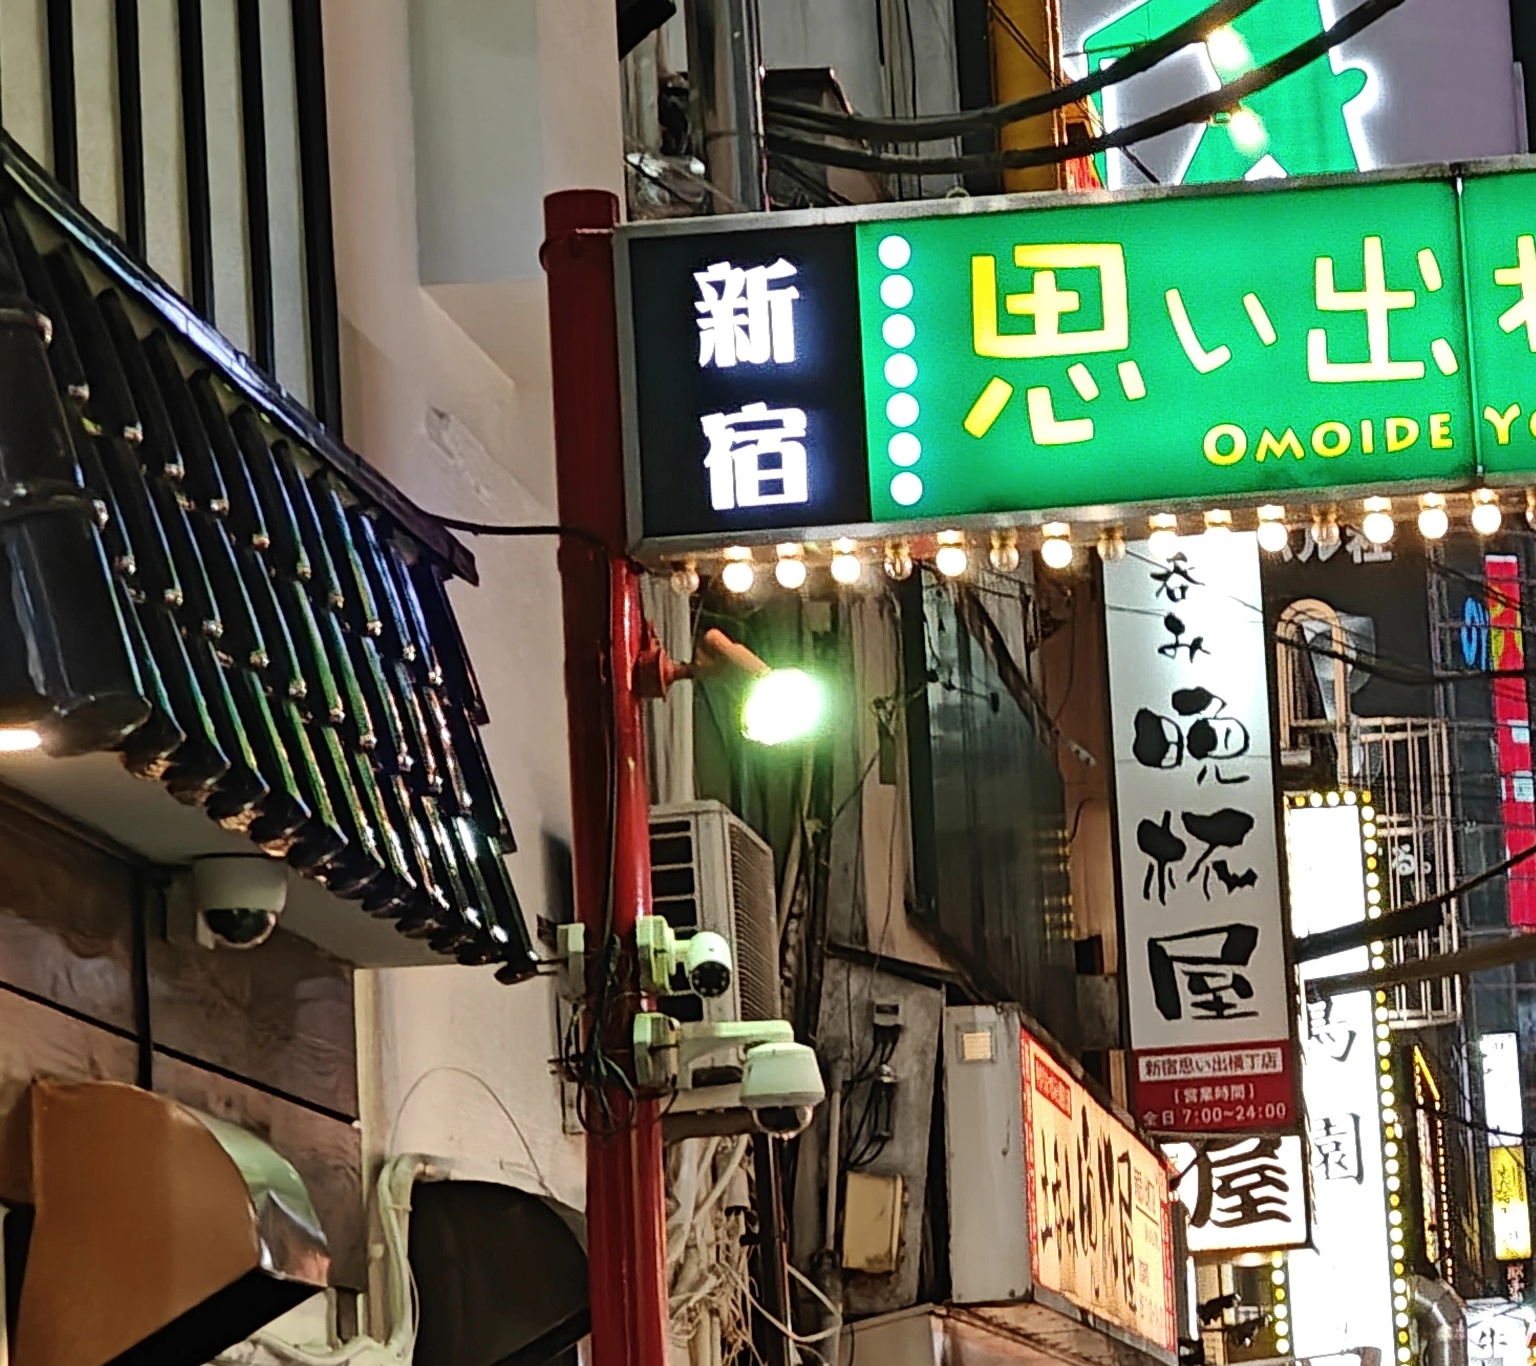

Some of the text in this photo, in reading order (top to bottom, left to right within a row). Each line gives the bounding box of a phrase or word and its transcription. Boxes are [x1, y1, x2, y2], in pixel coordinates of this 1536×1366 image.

[694, 257, 809, 511] 新宿
[1203, 411, 1455, 467] OMOIDE
[1282, 523, 1393, 564] ル社
[1132, 685, 1261, 1022] 晩杯屋
[1145, 1048, 1279, 1078] 新宿思い出横丁店
[1143, 1101, 1287, 1128] 全日 7:00~24:00
[1188, 1135, 1293, 1230] 屋
